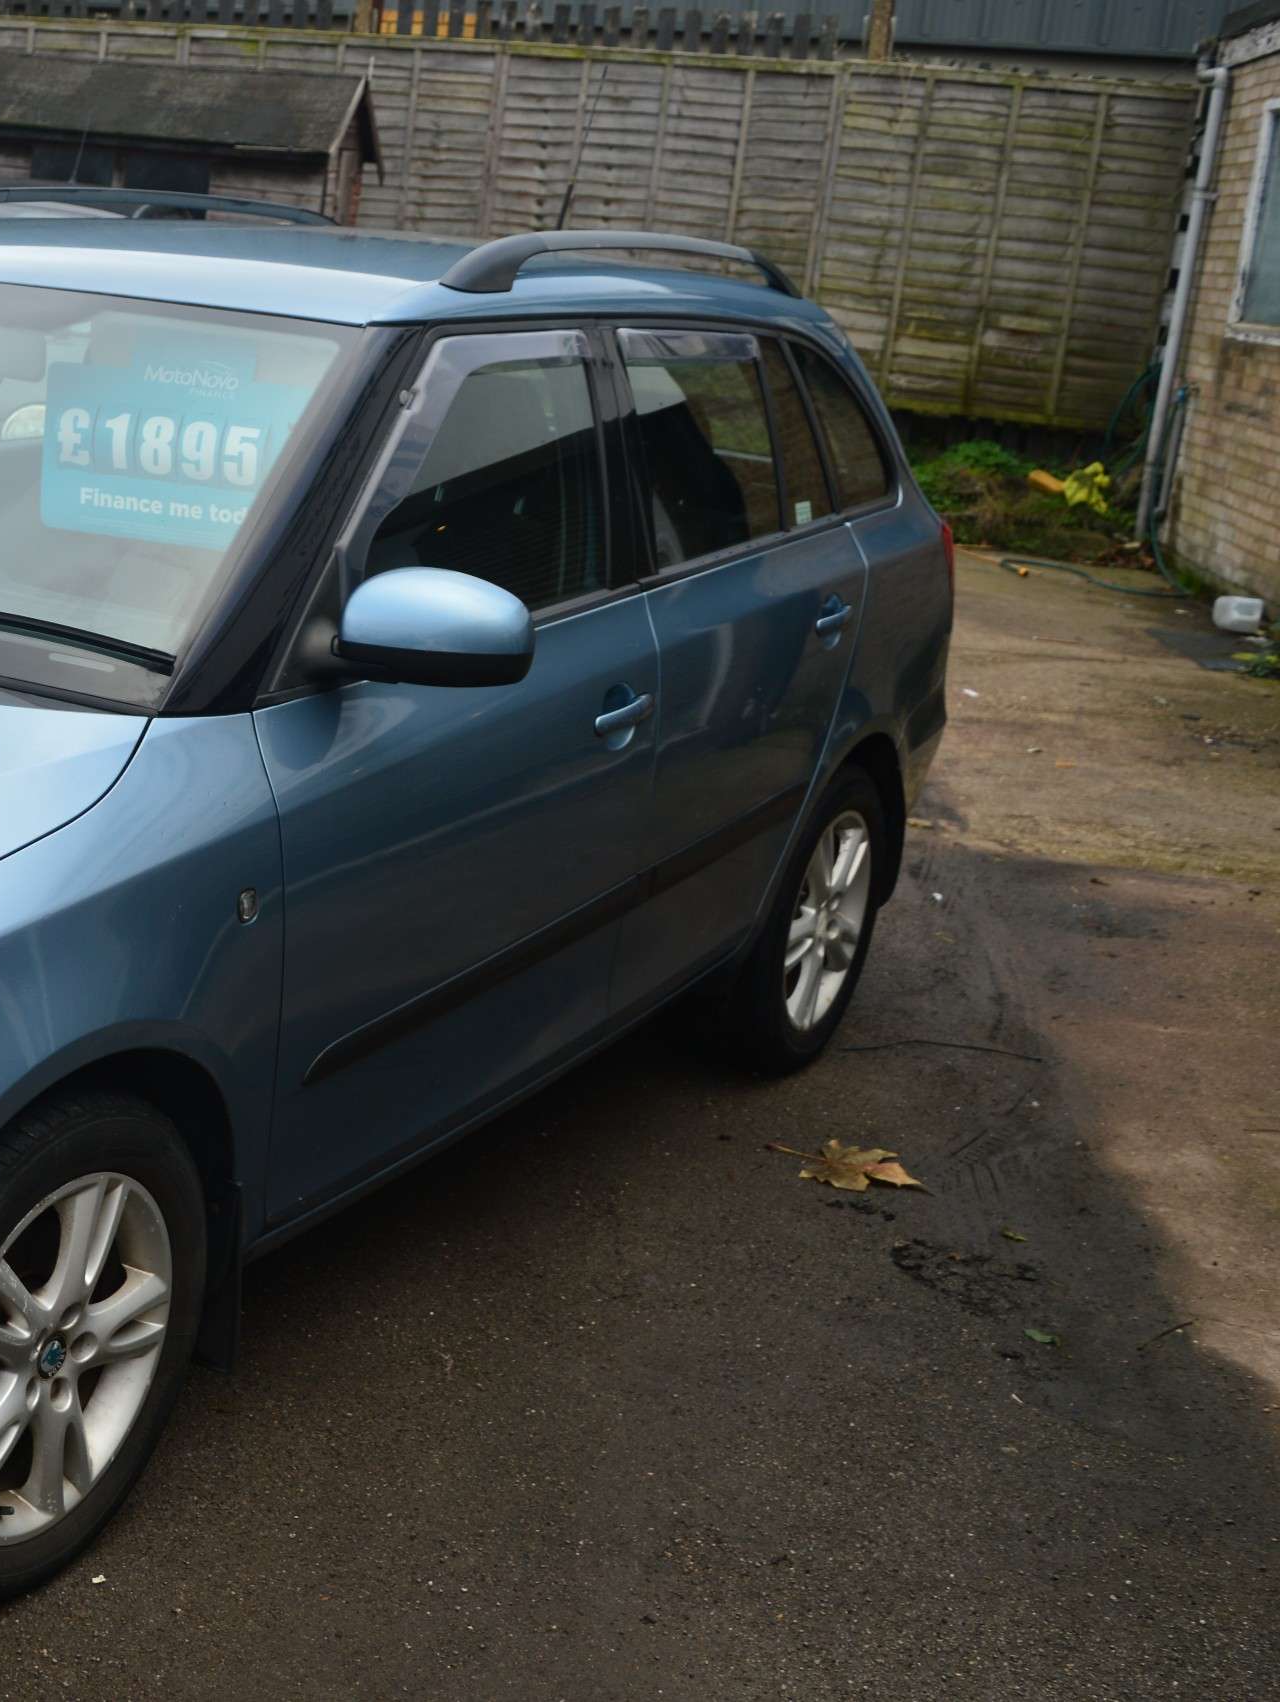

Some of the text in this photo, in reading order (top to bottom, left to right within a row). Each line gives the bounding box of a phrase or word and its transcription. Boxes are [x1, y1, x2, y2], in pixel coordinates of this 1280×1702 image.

[144, 363, 240, 391] MotoNovo
[57, 407, 261, 486] £1895
[80, 486, 163, 515] Finance
[169, 499, 204, 519] me
